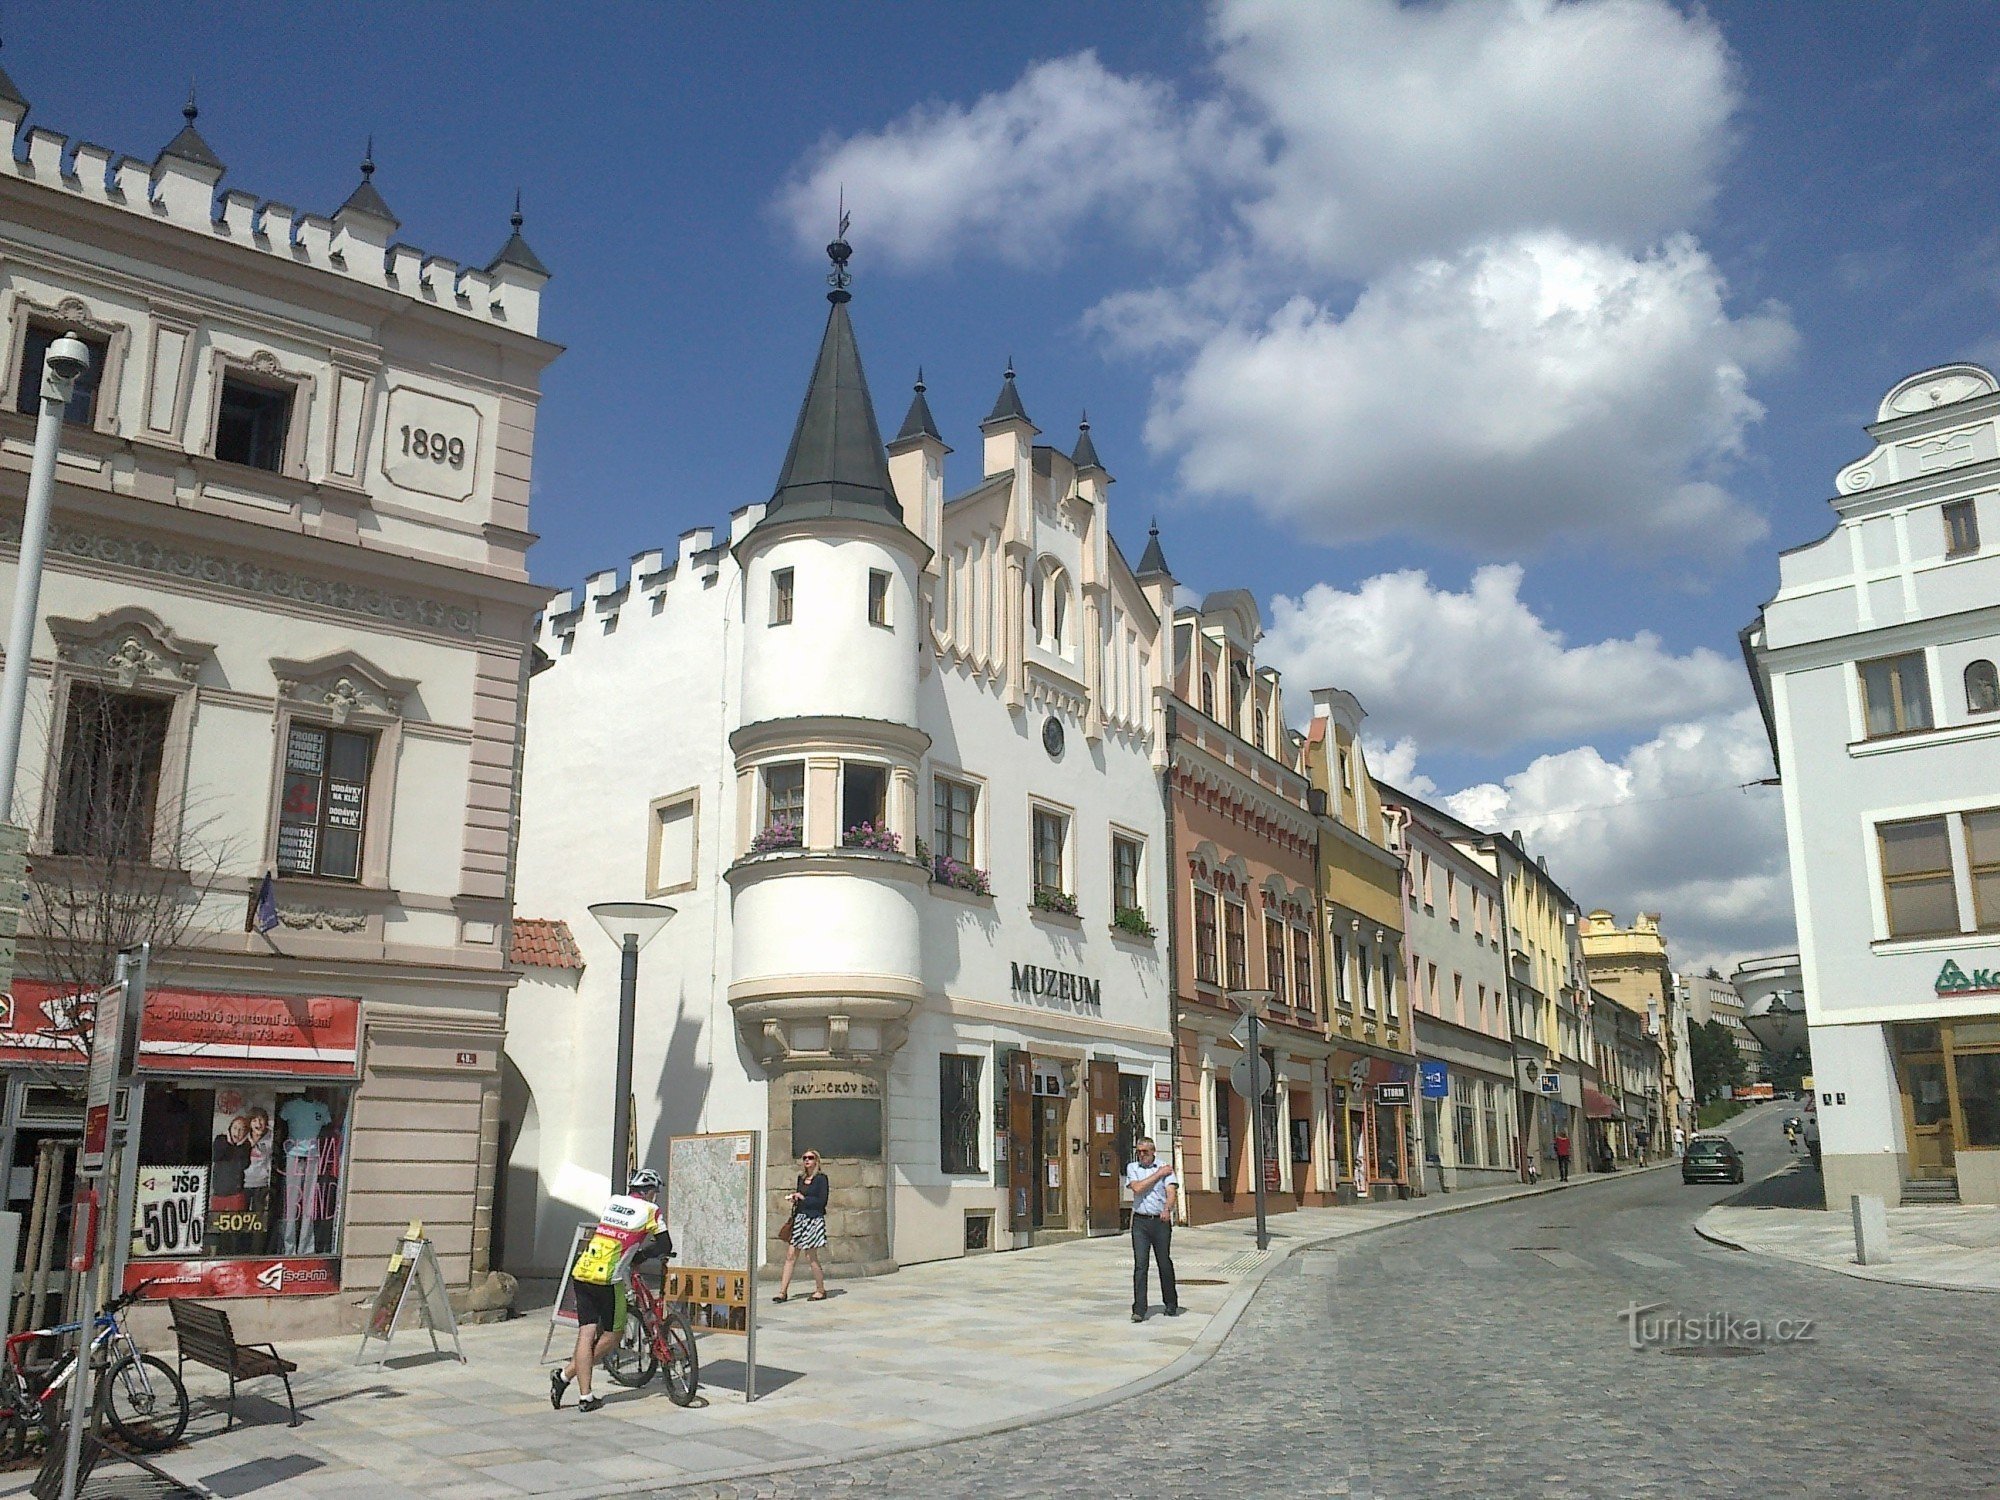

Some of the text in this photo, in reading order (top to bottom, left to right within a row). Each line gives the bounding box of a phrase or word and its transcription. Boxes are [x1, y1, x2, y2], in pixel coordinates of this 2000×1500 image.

[401, 424, 465, 471] 1899
[290, 731, 323, 743] PRODEJ
[289, 740, 323, 752] PRODEJ
[288, 750, 322, 762] PRODEJ
[287, 759, 321, 771] PRODEJ
[332, 793, 343, 801] NA
[330, 815, 341, 824] NA
[280, 826, 314, 838] MONTÁŽ
[279, 836, 313, 849] MONTÁŽ
[278, 847, 312, 860] MONTÁŽ
[277, 857, 311, 870] MONTÁŽ
[1010, 961, 1101, 1006] MUZEUM
[225, 1012, 281, 1029] sportovní
[1383, 1087, 1405, 1098] STORM
[171, 1170, 200, 1193] vše
[131, 1195, 201, 1252] -50%
[212, 1213, 262, 1231] -50%
